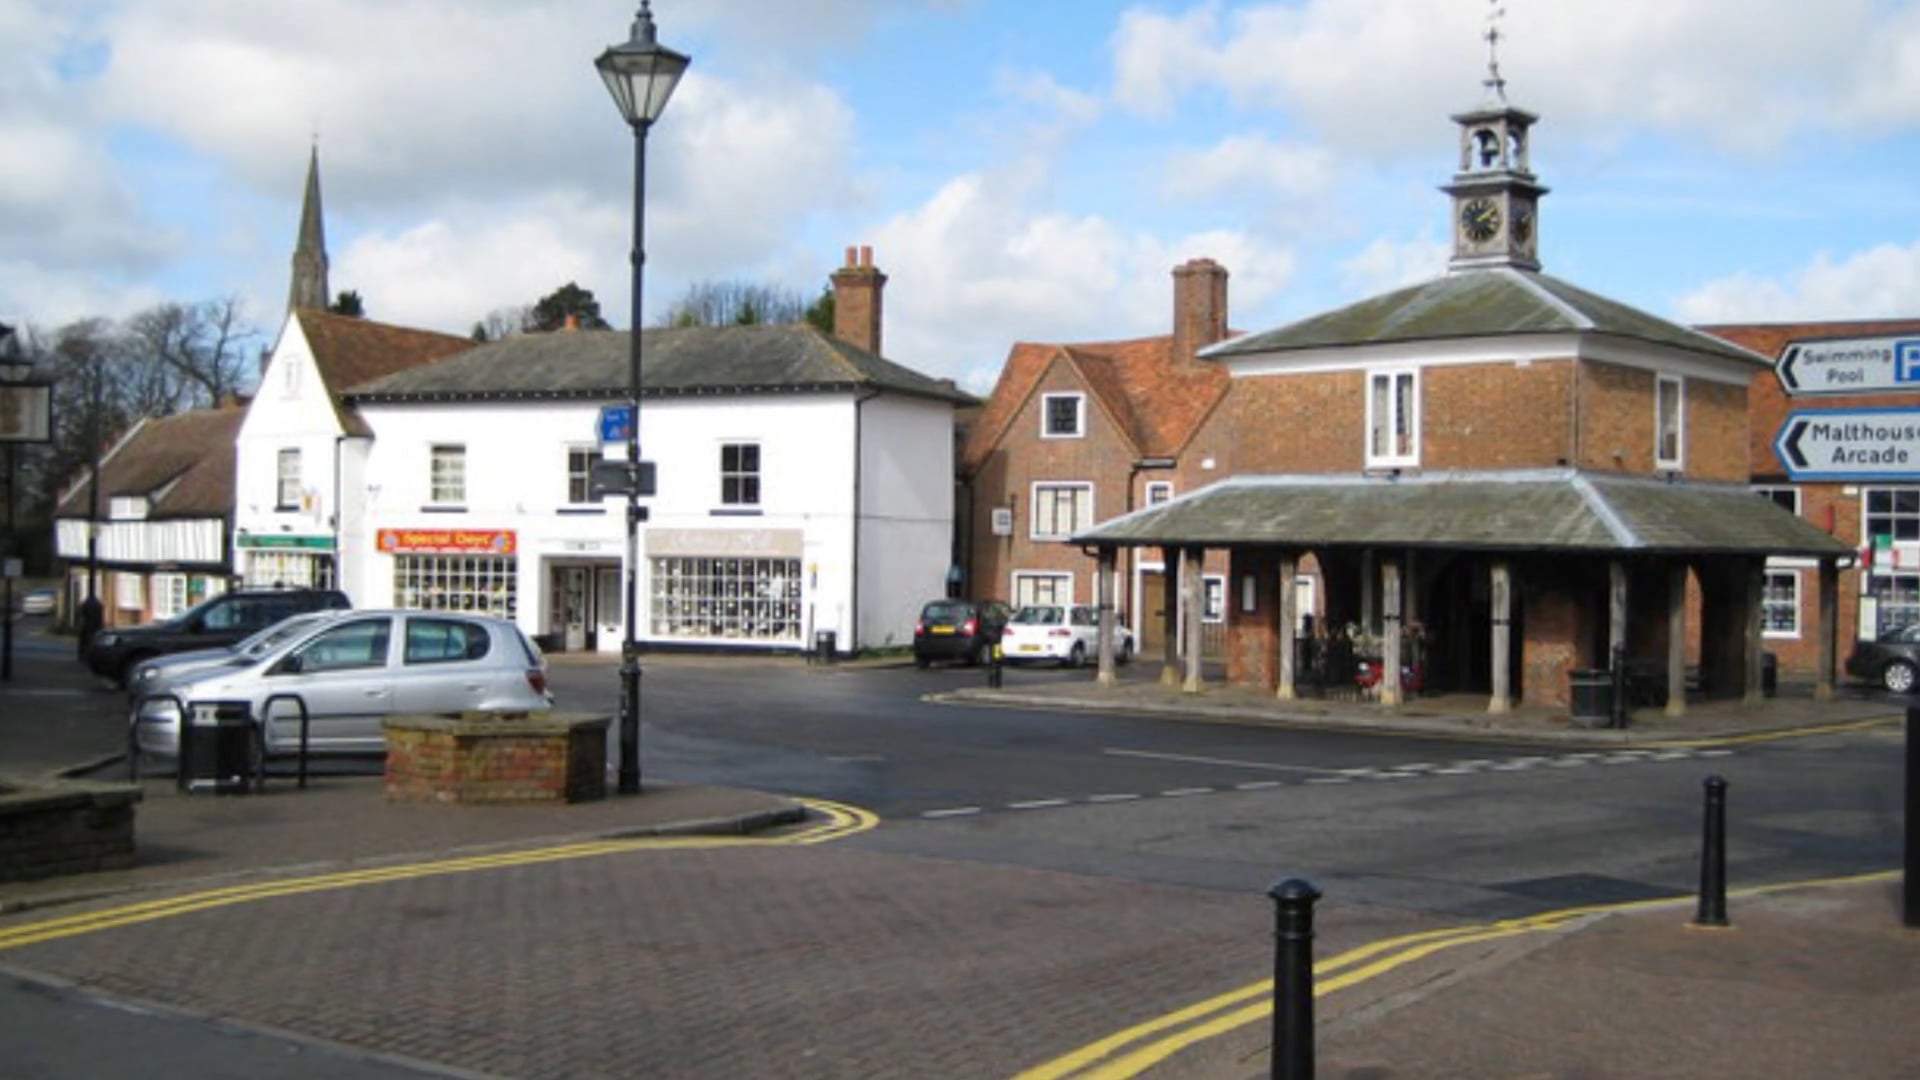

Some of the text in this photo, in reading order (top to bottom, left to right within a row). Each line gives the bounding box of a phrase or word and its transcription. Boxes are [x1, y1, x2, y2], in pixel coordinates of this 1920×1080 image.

[1803, 347, 1892, 366] Swimming
[1827, 368, 1864, 384] Pool
[1832, 446, 1908, 464] Arcade
